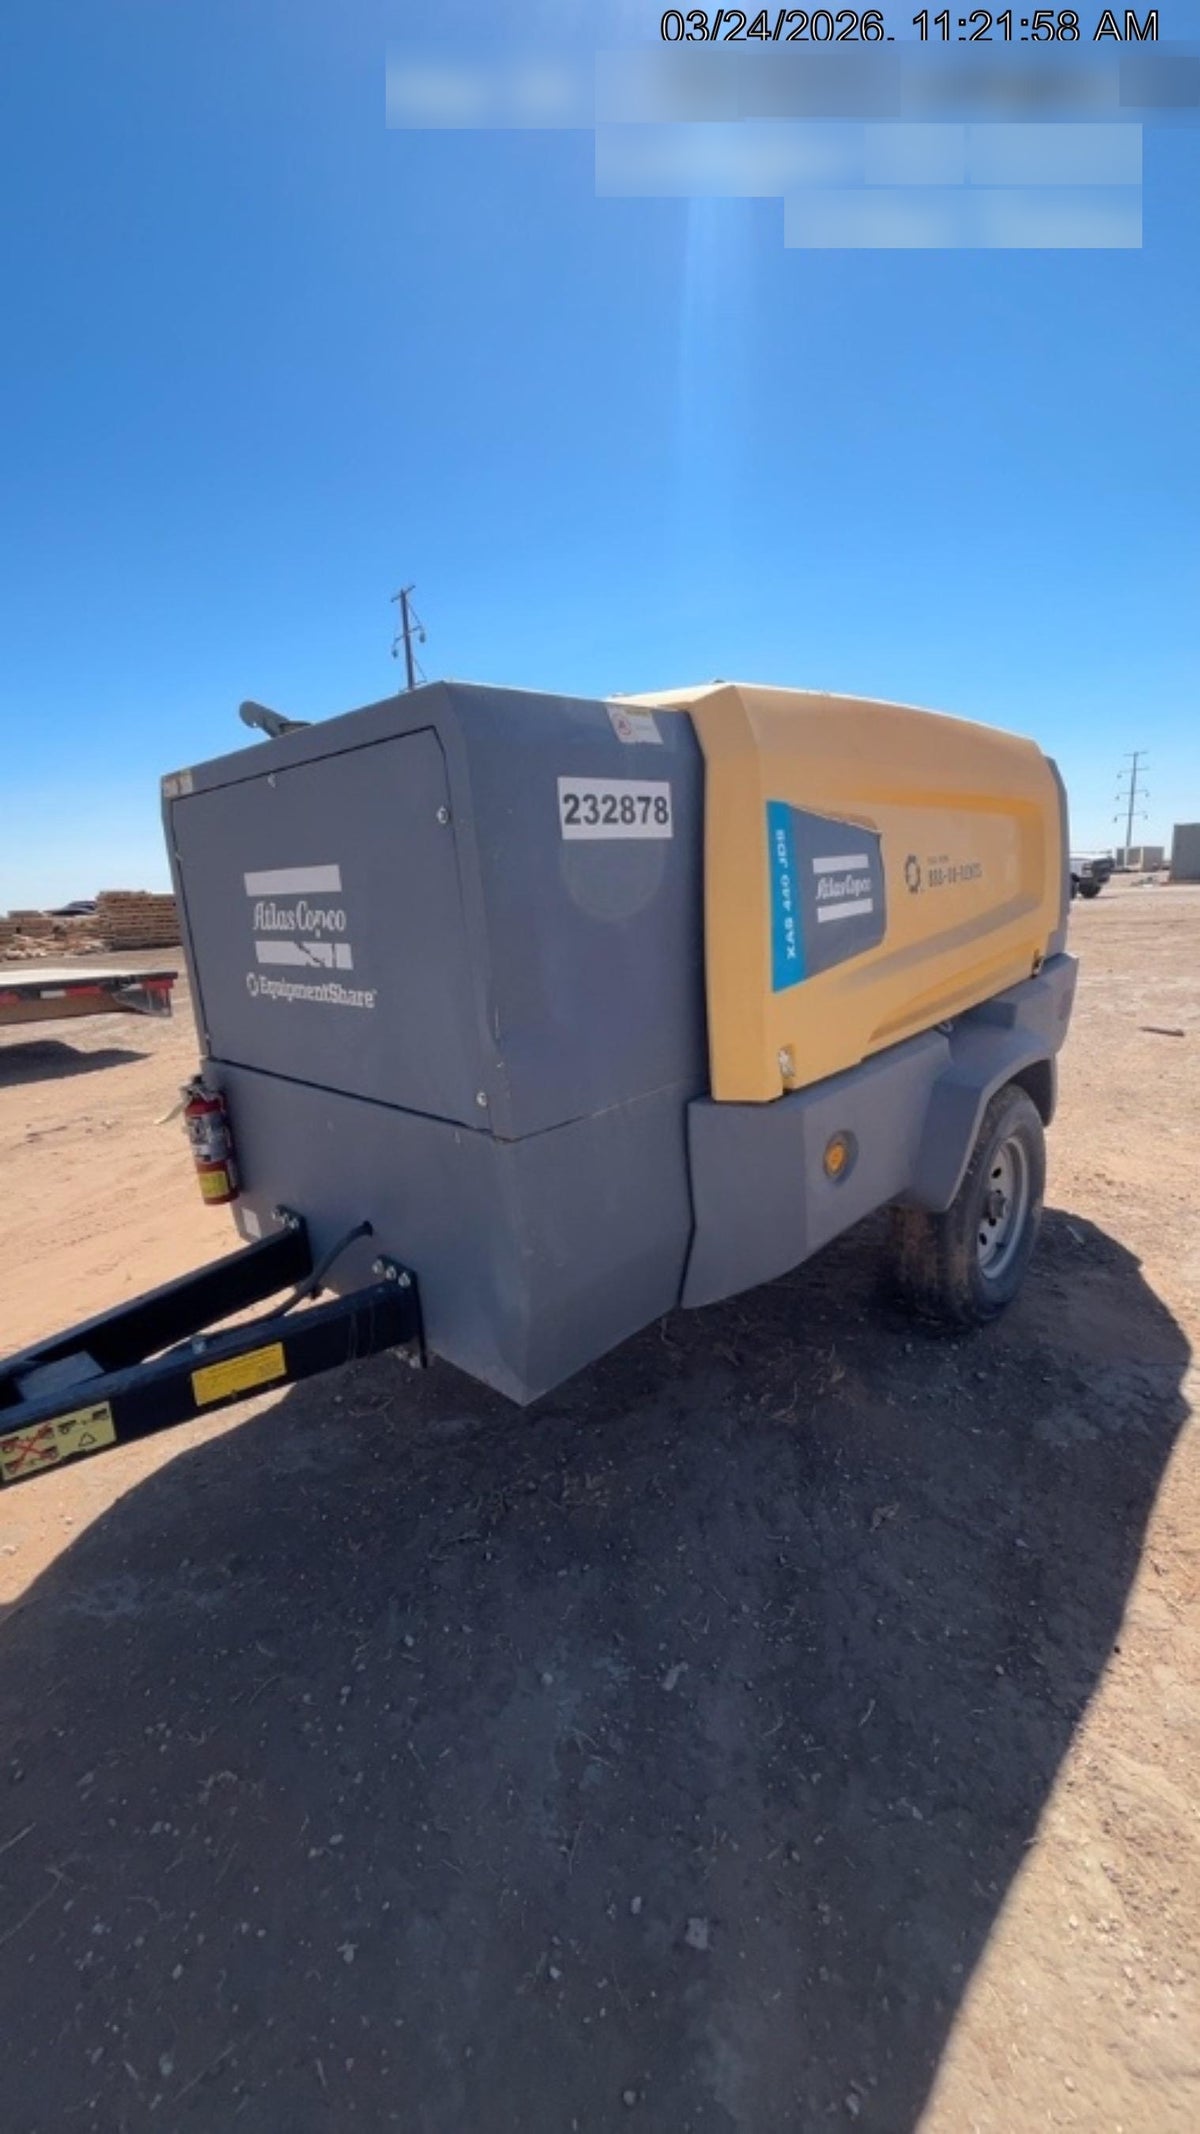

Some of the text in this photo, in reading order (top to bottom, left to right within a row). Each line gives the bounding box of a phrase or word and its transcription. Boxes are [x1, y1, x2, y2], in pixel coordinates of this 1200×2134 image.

[563, 793, 669, 825] 232878
[780, 873, 791, 911] 440
[253, 901, 346, 938] Atlas Copco
[784, 916, 796, 959] XAS
[260, 974, 375, 1008] EquipmentShare
